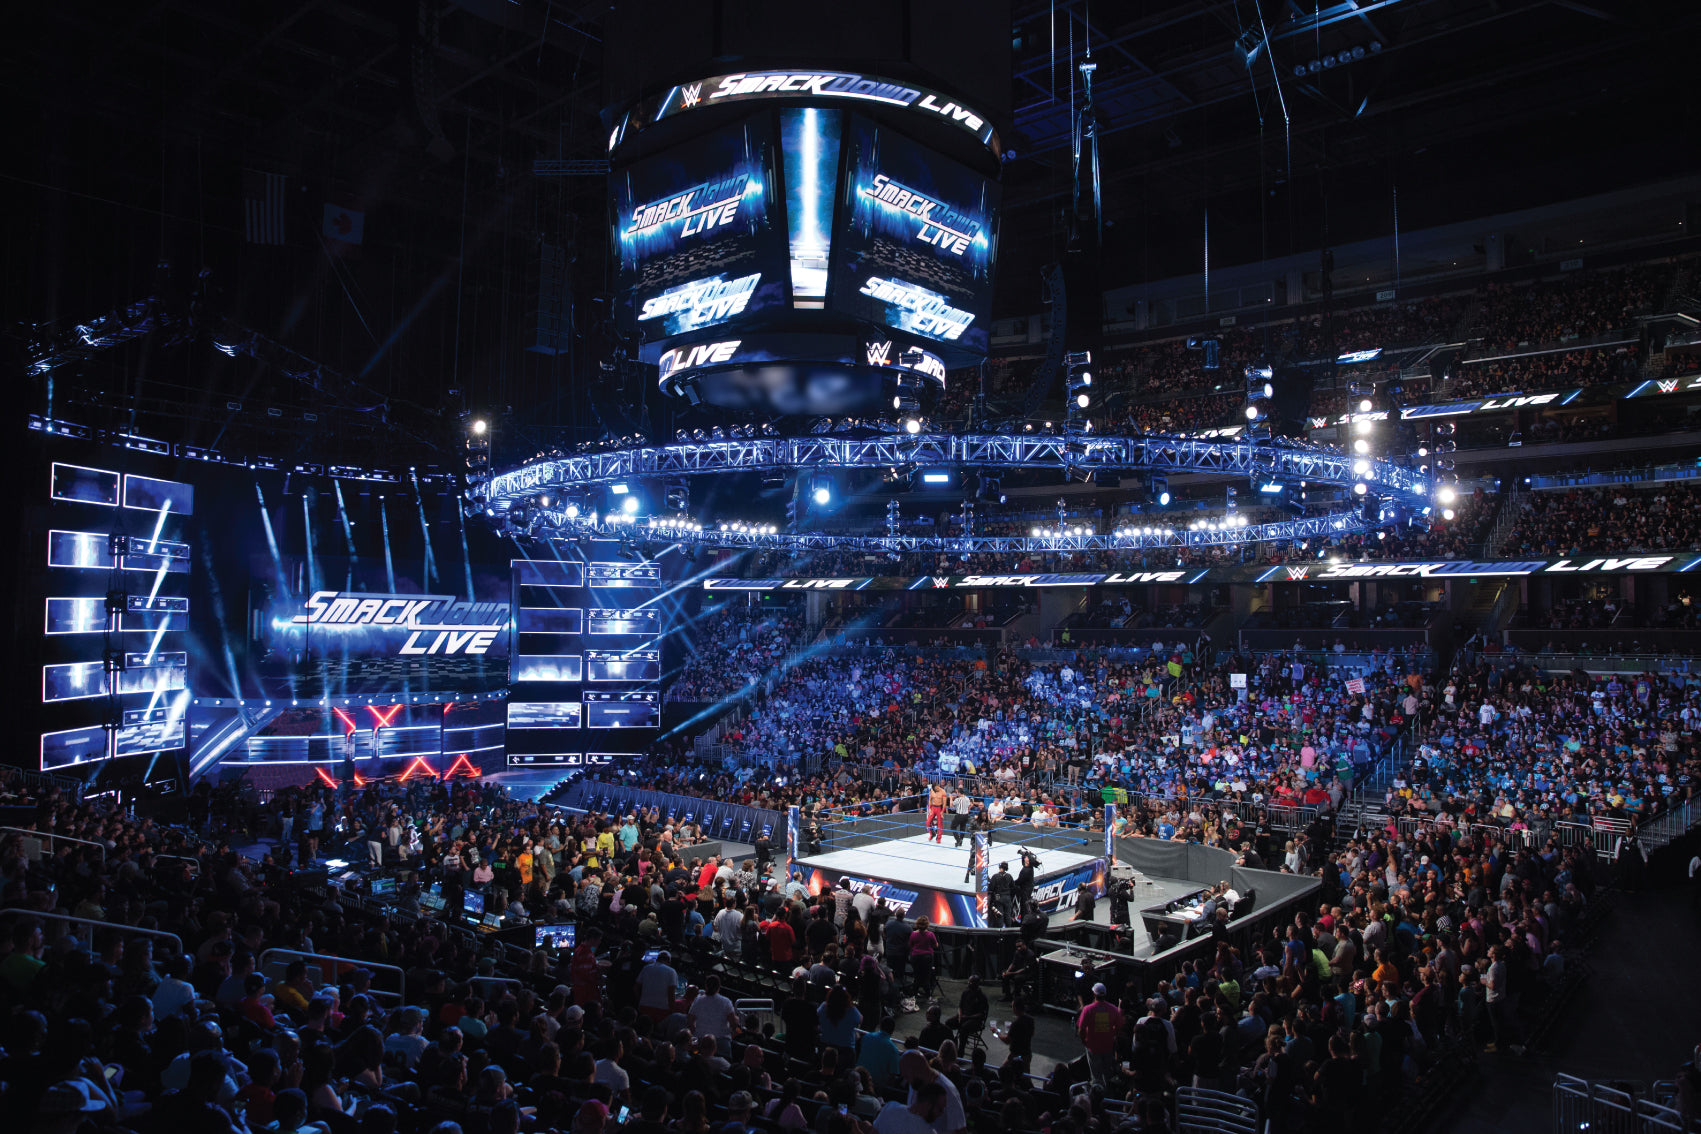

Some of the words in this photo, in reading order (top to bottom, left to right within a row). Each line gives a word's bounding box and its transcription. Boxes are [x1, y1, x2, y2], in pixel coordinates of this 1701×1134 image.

[918, 94, 984, 131] LIVE
[680, 201, 740, 238] LIVE
[916, 224, 970, 256] LIVE
[672, 341, 742, 371] LIVE
[1480, 394, 1559, 410] LIVE
[1544, 556, 1674, 572] LIVE
[782, 580, 854, 588] LIVE
[1104, 571, 1186, 583] LIVE
[399, 631, 499, 655] LIVE
